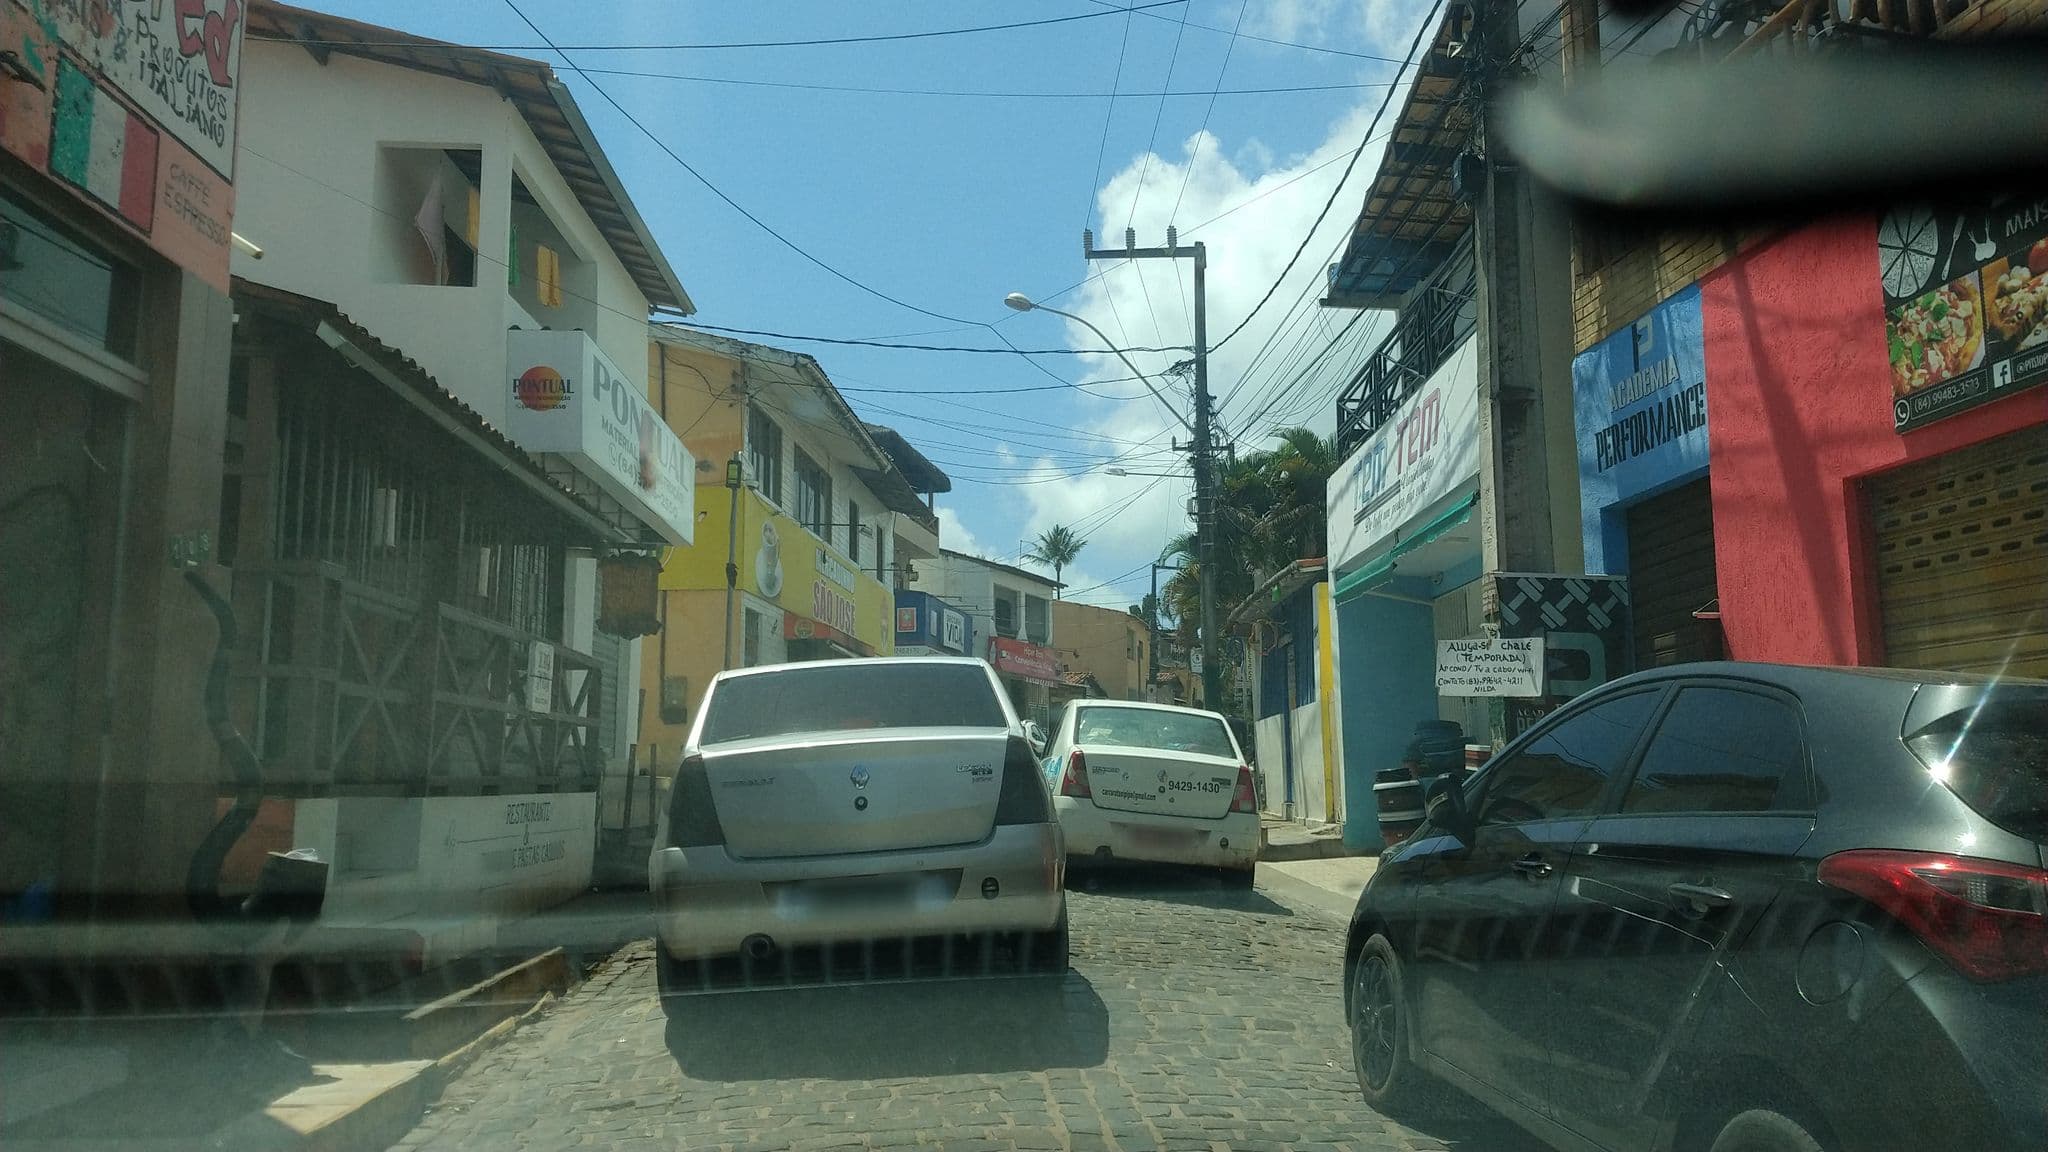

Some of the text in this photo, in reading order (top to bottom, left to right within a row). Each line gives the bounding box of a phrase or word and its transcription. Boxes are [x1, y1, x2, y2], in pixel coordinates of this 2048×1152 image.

[513, 378, 575, 394] PONTUAL
[1611, 352, 1681, 414] ACADEMIA
[1914, 396, 1931, 413] (84)
[601, 415, 638, 462] MATERIAL
[1594, 381, 1706, 474] PERFORMANCE
[812, 579, 856, 637] SÃO JOSÉ
[1473, 685, 1496, 693] NILDA
[1168, 780, 1220, 794] 9429-1430
[506, 802, 551, 825] RESTAURANTE
